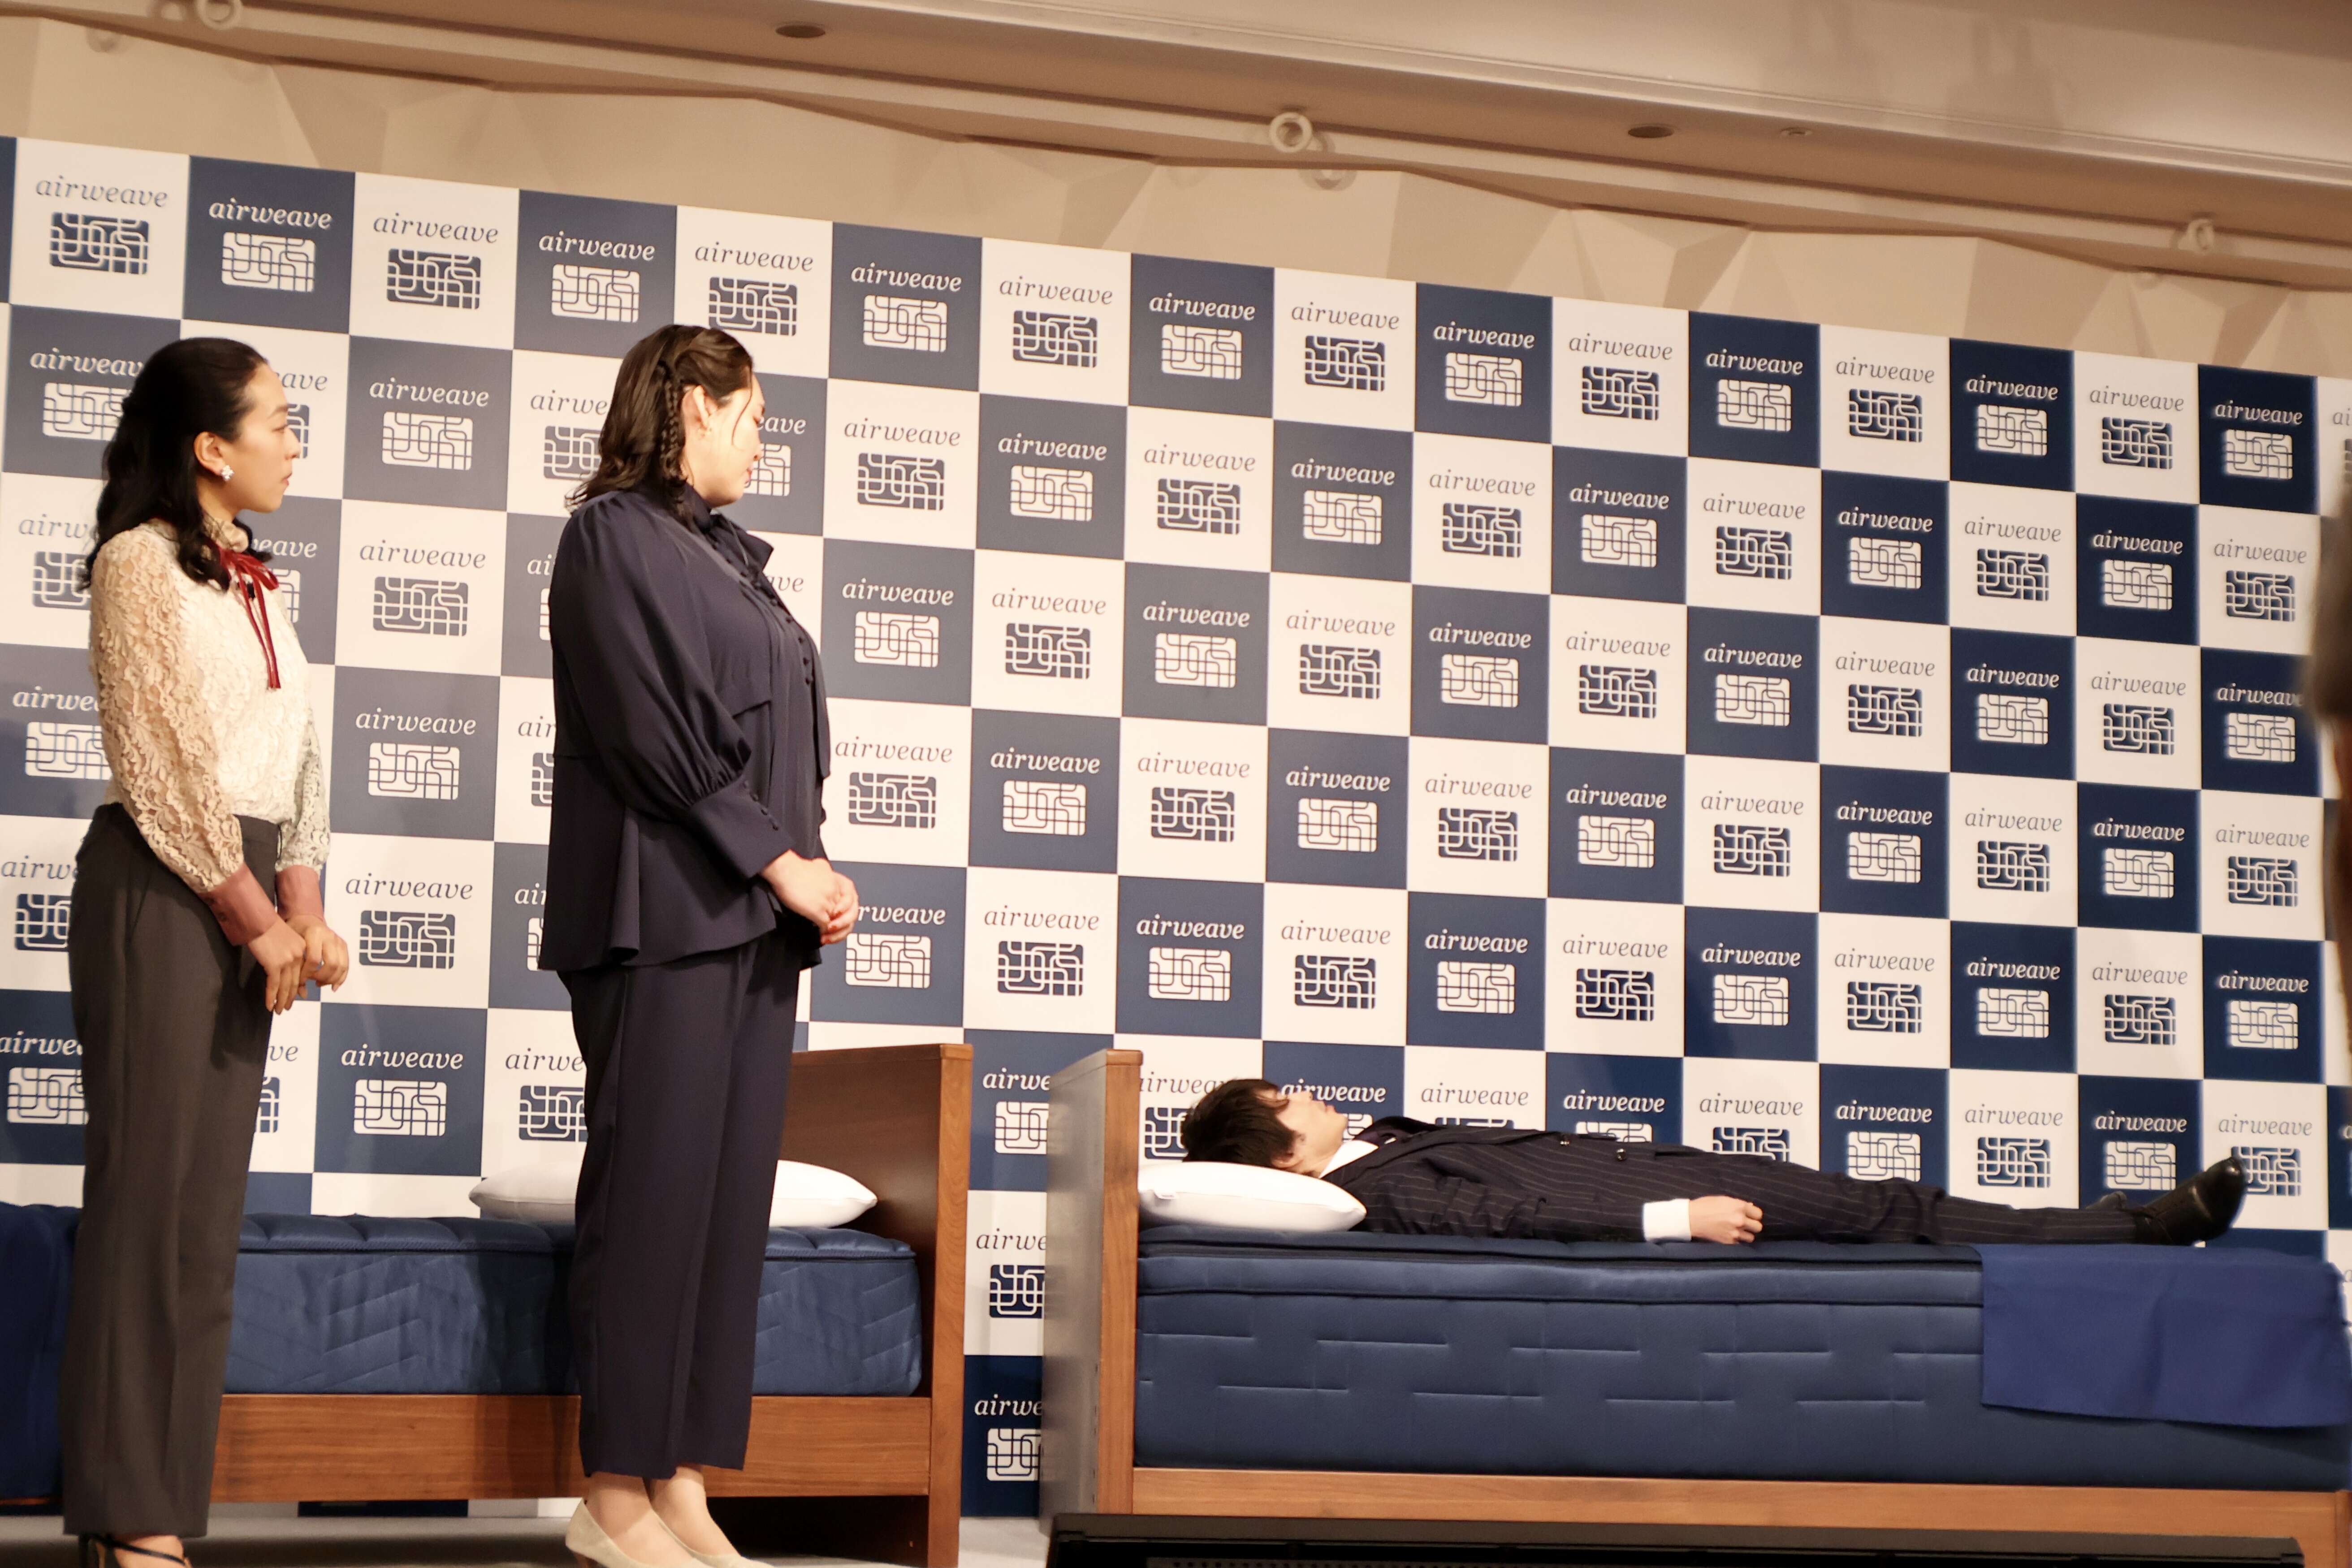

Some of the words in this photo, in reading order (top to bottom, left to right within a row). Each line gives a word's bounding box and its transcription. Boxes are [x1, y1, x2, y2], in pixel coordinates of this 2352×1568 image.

[35, 175, 168, 207] airweave
[209, 198, 332, 229] airweave
[373, 212, 498, 243] airweave
[539, 231, 655, 261] airweave
[695, 242, 813, 272] airweave
[851, 262, 962, 292] airweave
[999, 276, 1113, 305] airweave
[1149, 292, 1255, 321] airweave
[1291, 302, 1399, 330] airweave
[1433, 321, 1535, 349] airweave
[1569, 333, 1673, 360] airweave
[30, 347, 144, 377] airweav
[1706, 349, 1803, 375] airweave
[1836, 357, 1935, 384] airweave
[370, 377, 489, 407] airweave
[1966, 374, 2058, 400] airweave
[2089, 385, 2184, 411] airweave
[530, 389, 609, 416] airwe
[2214, 400, 2303, 425] airweave
[844, 418, 960, 446] airweave
[998, 433, 1107, 461] airweave
[1144, 444, 1255, 472] airweave
[1291, 458, 1395, 485] airweave
[1429, 469, 1535, 496] airweave
[1569, 483, 1669, 510] airweave
[1703, 493, 1805, 519] airweave
[18, 514, 88, 538] airw
[1838, 506, 1933, 532] airweave
[1964, 516, 2061, 542] airweave
[359, 540, 486, 569] airweave
[2092, 530, 2183, 554] airweave
[2214, 539, 2307, 564] airweave
[842, 578, 954, 605] airweave
[992, 587, 1106, 615] airweave
[1143, 600, 1250, 627] airweave
[1286, 609, 1395, 636] airweave
[1429, 622, 1531, 648] airweave
[1566, 631, 1670, 657] airweave
[1704, 643, 1802, 668] airweave
[1835, 651, 1935, 677] airweave
[1966, 663, 2059, 688] airweave
[2091, 671, 2186, 696] airweave
[13, 685, 99, 712] airwe
[356, 707, 476, 735] airweave
[835, 736, 952, 763] airweave
[990, 747, 1100, 774] airweave
[1137, 752, 1250, 778] airweave
[1285, 765, 1390, 791] airweave
[1425, 773, 1532, 799] airweave
[1566, 783, 1667, 809] airweave
[1701, 790, 1804, 815] airweave
[1837, 800, 1933, 825] airweave
[1965, 808, 2062, 832] airweave
[2093, 817, 2185, 841] airweave
[2215, 824, 2309, 848] airweave
[1, 855, 77, 879] airw
[346, 873, 473, 900] airweave
[858, 905, 946, 925] rweave
[984, 905, 1099, 930] airweave
[1136, 914, 1245, 939] airweave
[1281, 920, 1391, 945] airweave
[1425, 929, 1528, 953] airweave
[1563, 934, 1668, 959] airweave
[1701, 942, 1801, 967] airweave
[1834, 948, 1935, 972] airweave
[1967, 957, 2060, 980] airweave
[2092, 961, 2188, 985] airweave
[2218, 970, 2309, 993] airweave
[0, 1030, 83, 1056] airwe
[341, 1044, 463, 1069] airweave
[505, 1047, 584, 1072] airwe
[982, 1067, 1051, 1091] airwe
[1421, 1082, 1529, 1106] airweave
[1563, 1089, 1665, 1113] airweave
[1699, 1093, 1803, 1116] airweave
[1835, 1100, 1932, 1123] airweave
[1965, 1103, 2063, 1126] airweave
[2094, 1110, 2187, 1132] airweave
[2218, 1114, 2313, 1136] airweave
[976, 1227, 1047, 1251] airwe
[974, 1393, 1043, 1416] airwe
